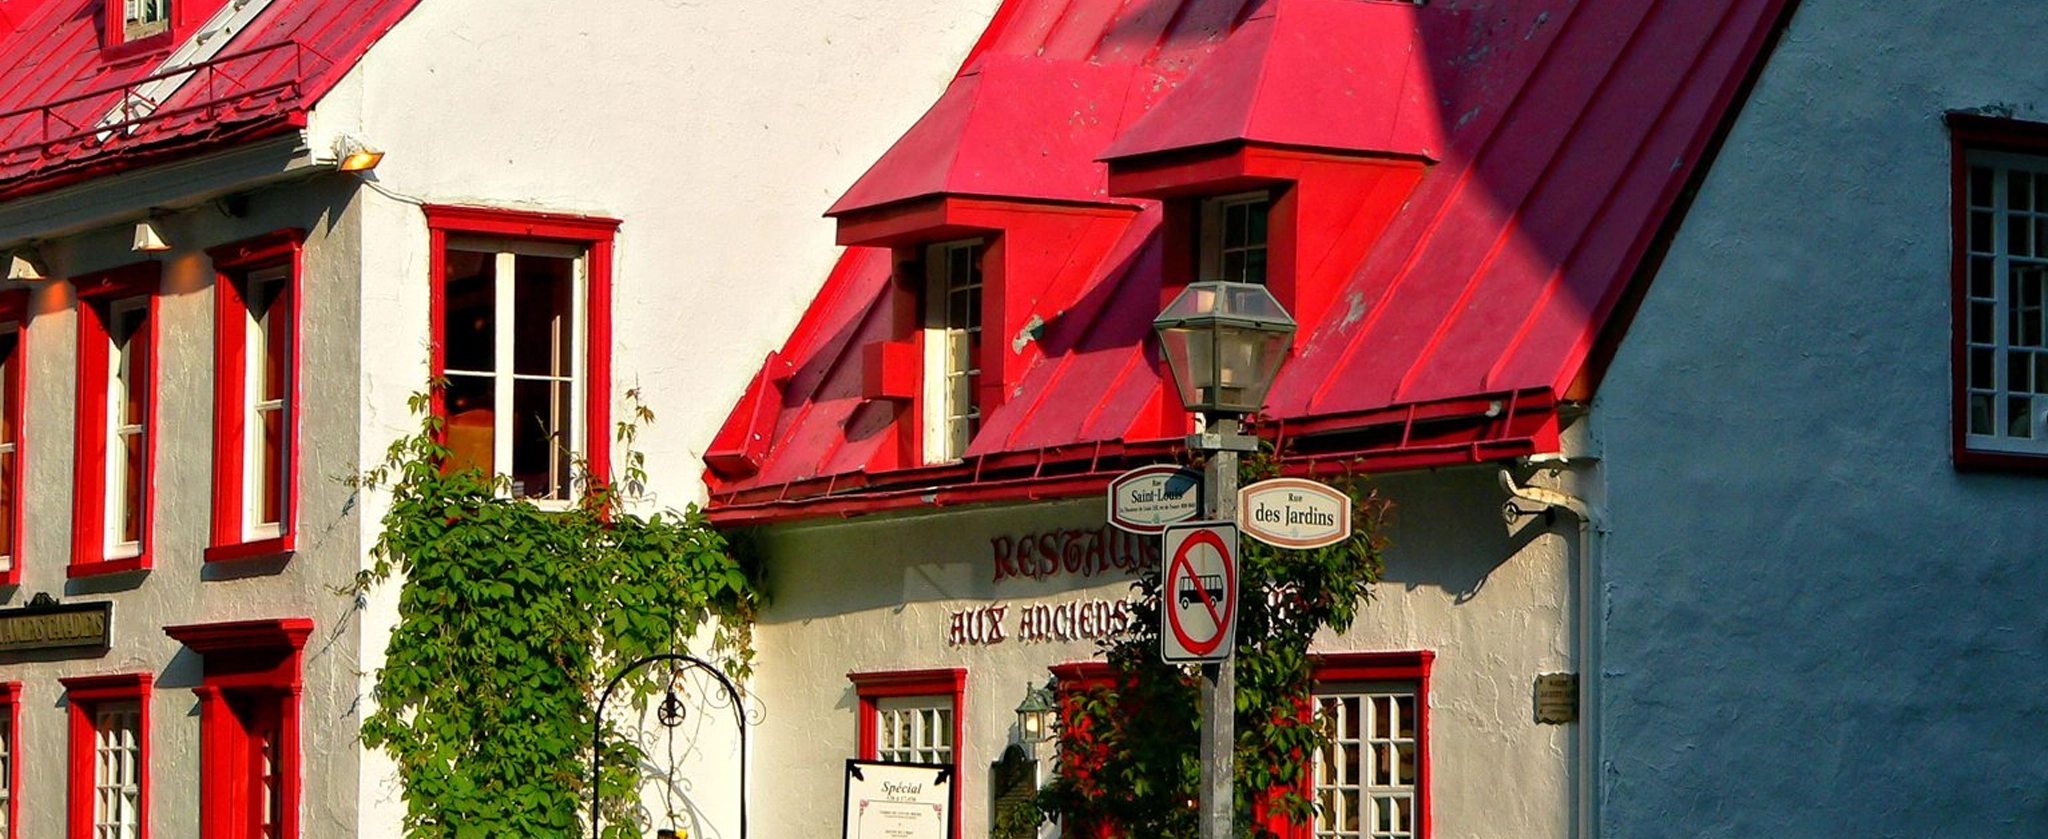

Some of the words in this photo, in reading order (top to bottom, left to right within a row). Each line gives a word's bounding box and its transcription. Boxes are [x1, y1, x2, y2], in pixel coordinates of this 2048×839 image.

[1131, 488, 1184, 504] Saint-Louis
[1288, 492, 1303, 502] Rue
[1255, 502, 1281, 523] des
[1285, 505, 1334, 527] Jardins
[991, 526, 1161, 583] RESTAUR
[950, 604, 1007, 648] AUX
[1019, 598, 1129, 645] ANCIENS
[881, 780, 923, 796] Spécial
